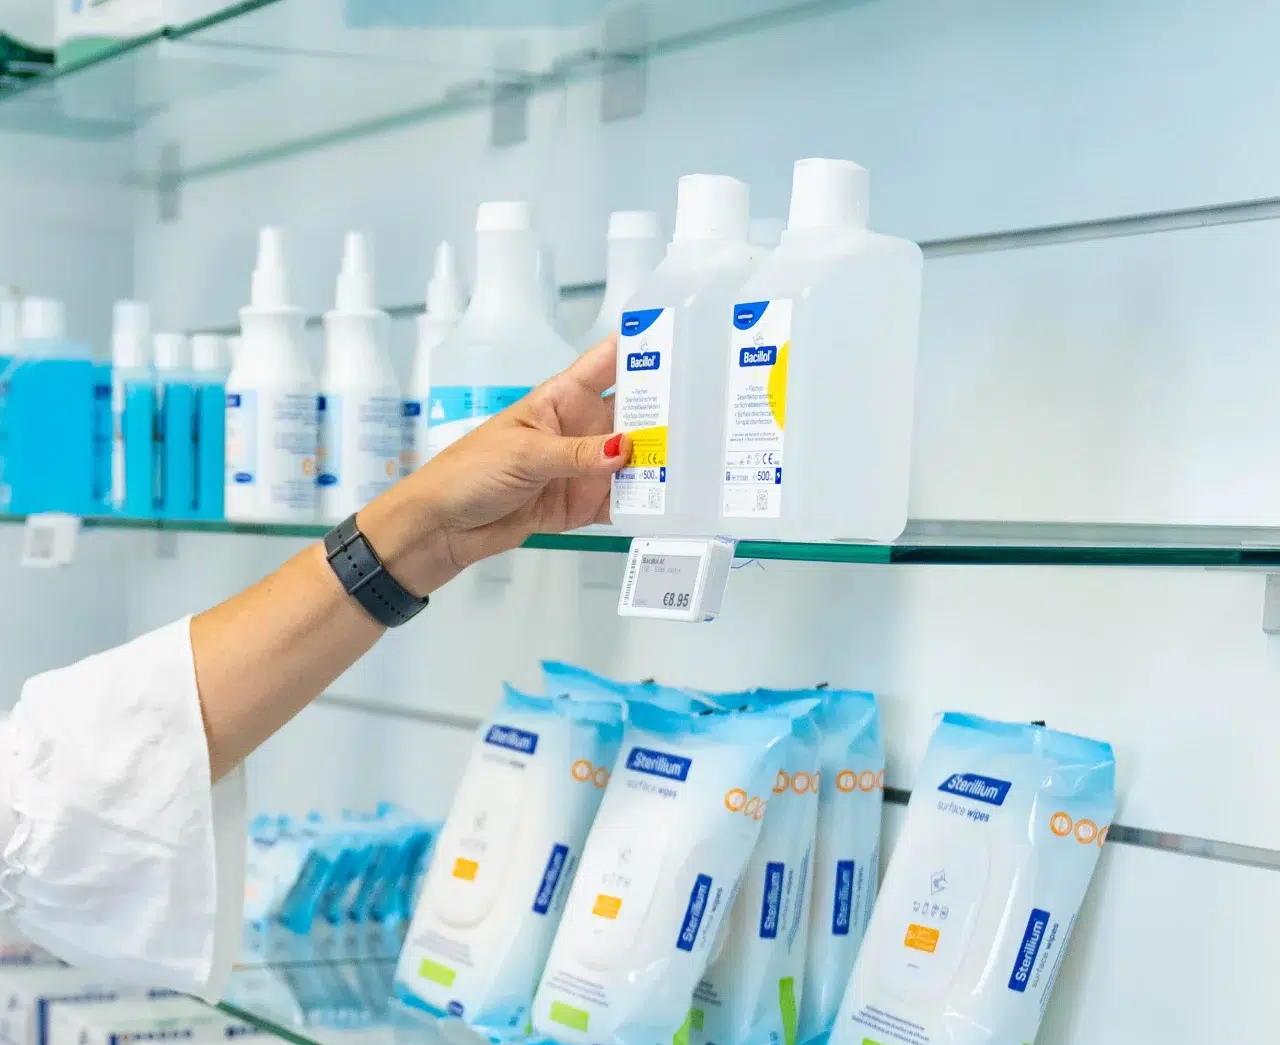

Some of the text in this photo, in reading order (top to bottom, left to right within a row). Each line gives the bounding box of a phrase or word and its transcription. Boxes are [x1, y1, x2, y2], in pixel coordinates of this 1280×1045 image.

[630, 355, 655, 368] Bacillol
[743, 349, 771, 363] Bacillol
[643, 469, 655, 479] 500
[757, 470, 770, 481] 500
[663, 592, 690, 607] €8.95
[634, 751, 683, 777] Sterillium
[947, 775, 999, 801] Sterillium
[937, 798, 990, 822] surface wipes
[682, 883, 708, 943] Sterillium
[1015, 920, 1045, 982] Sterillium
[1031, 951, 1050, 989] surface
[1045, 922, 1060, 950] wipes
